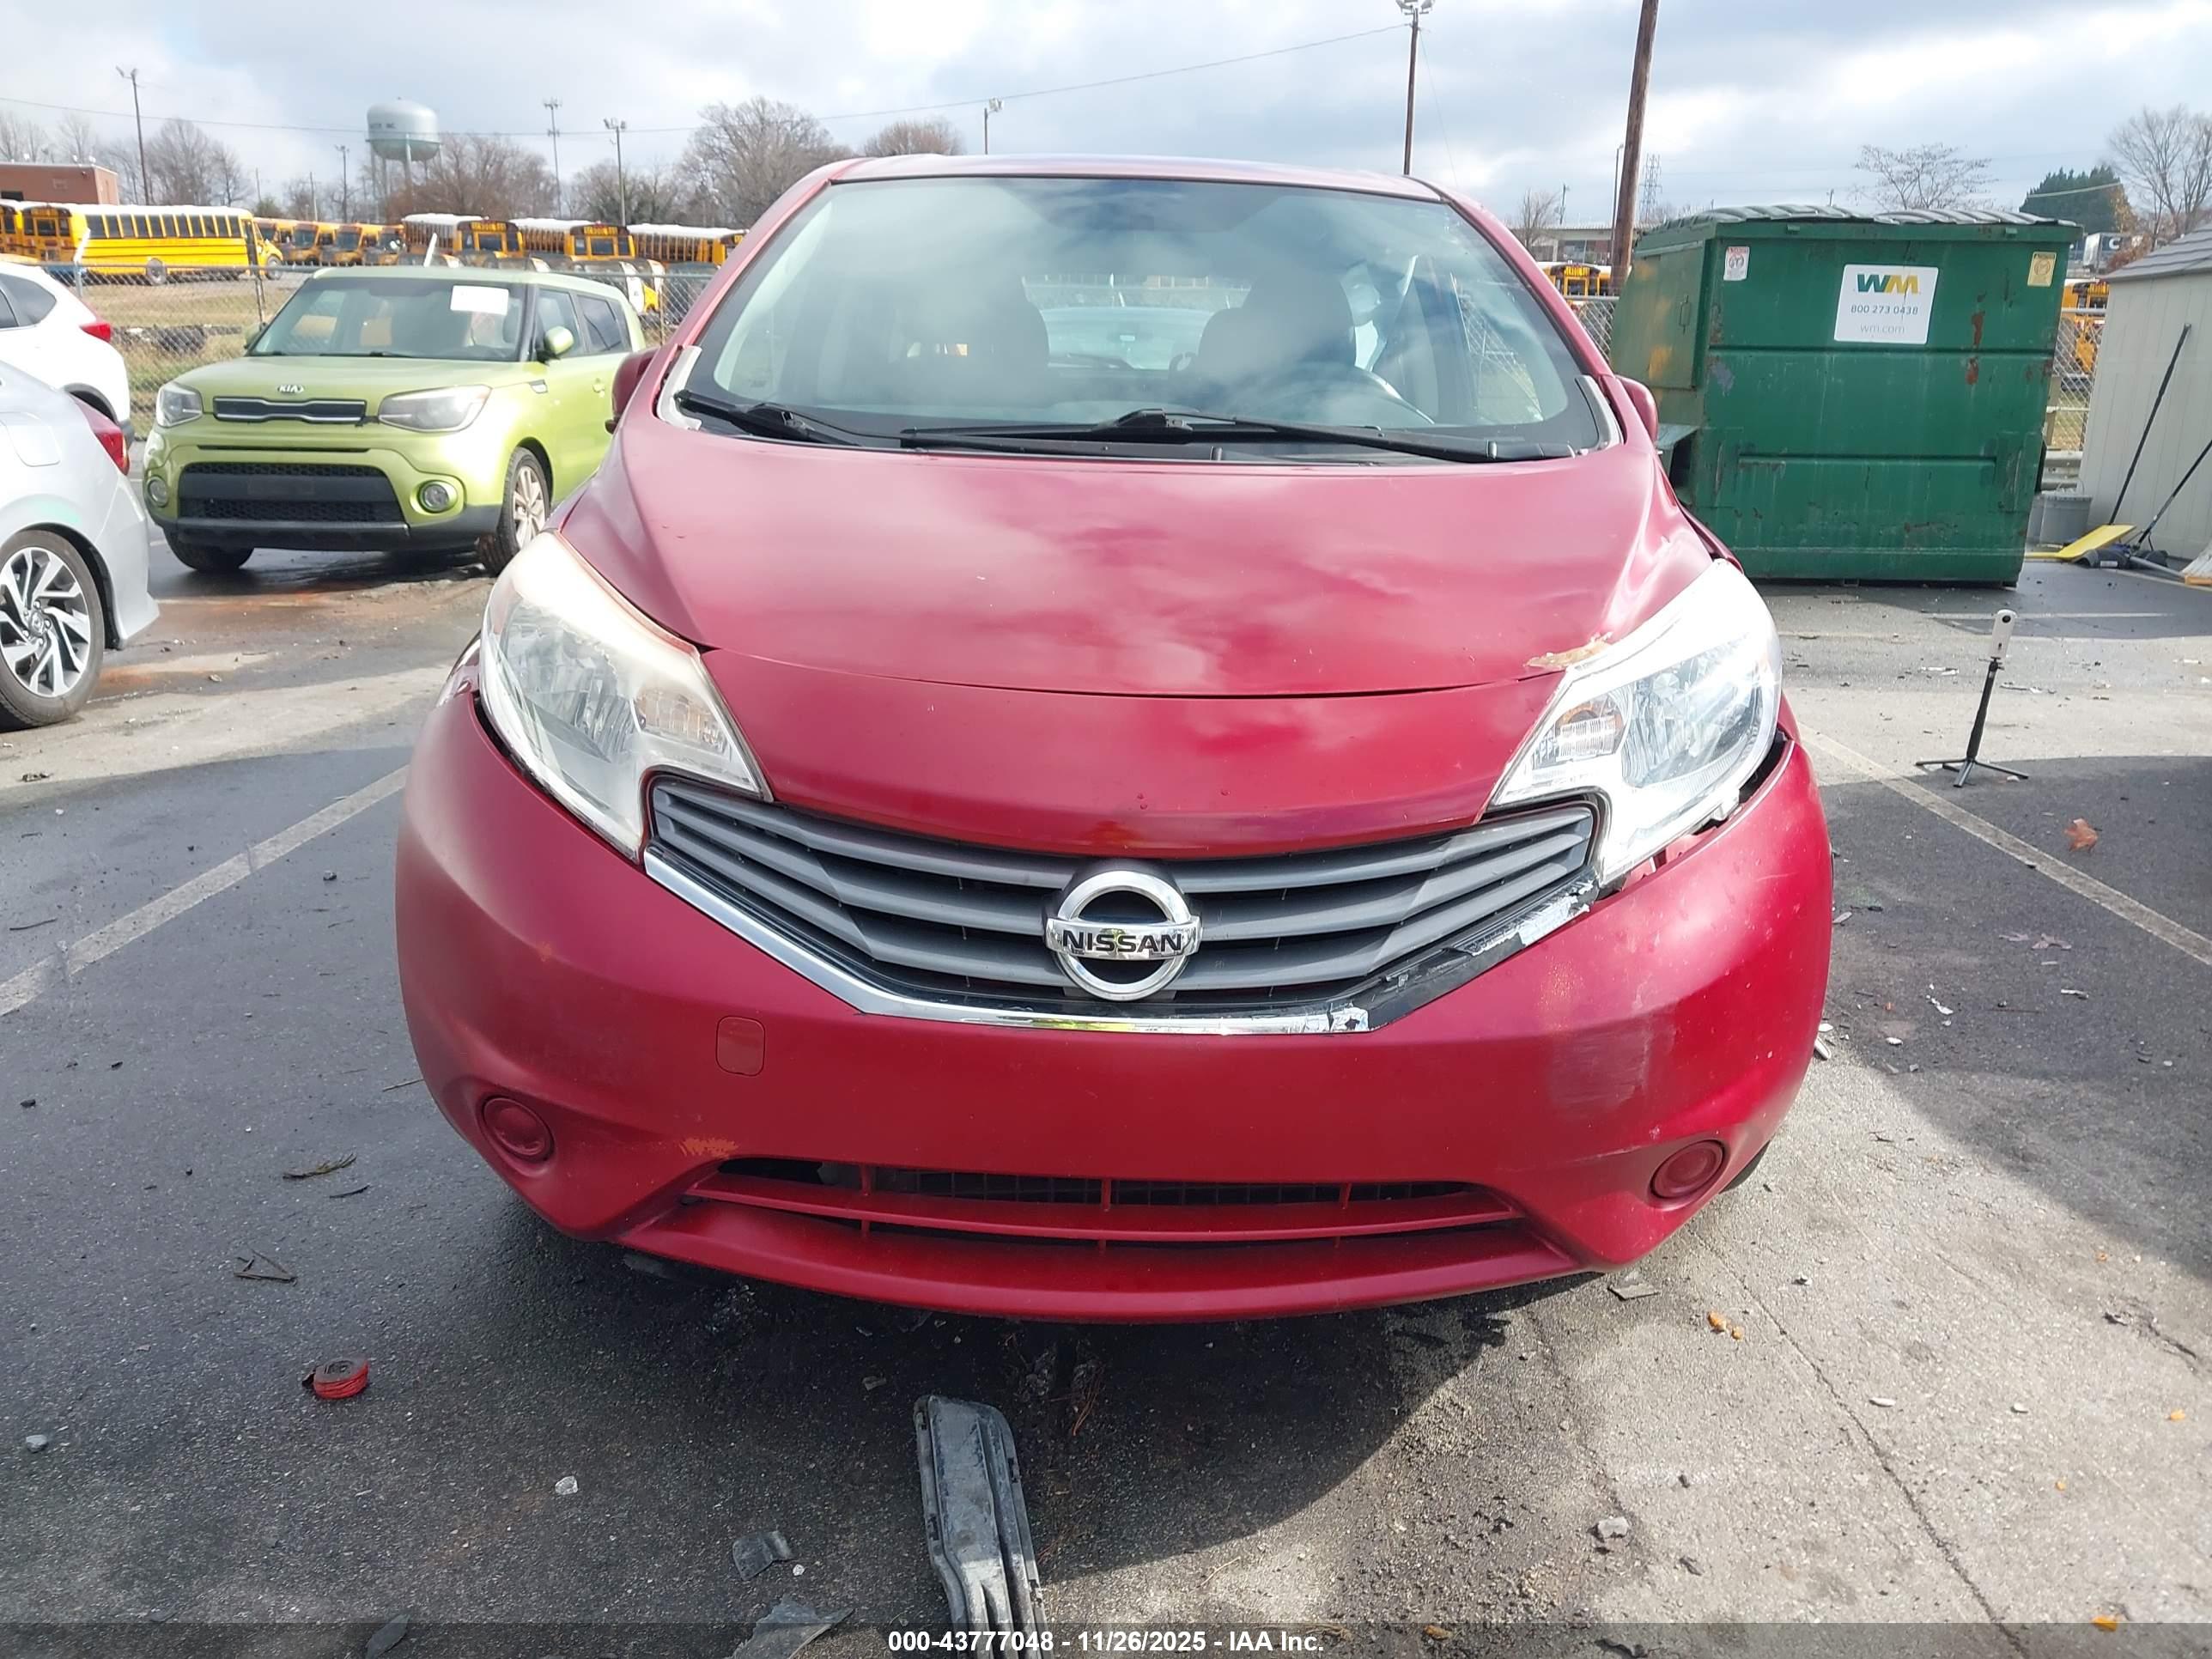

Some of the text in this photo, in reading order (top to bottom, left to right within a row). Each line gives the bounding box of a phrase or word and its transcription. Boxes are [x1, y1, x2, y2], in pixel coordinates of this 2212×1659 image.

[1856, 274, 1919, 295] WM
[1850, 305, 1918, 315] 800 273 0438
[1860, 324, 1905, 334] wm.com
[278, 384, 299, 393] KIA
[1062, 930, 1182, 953] NISSAN
